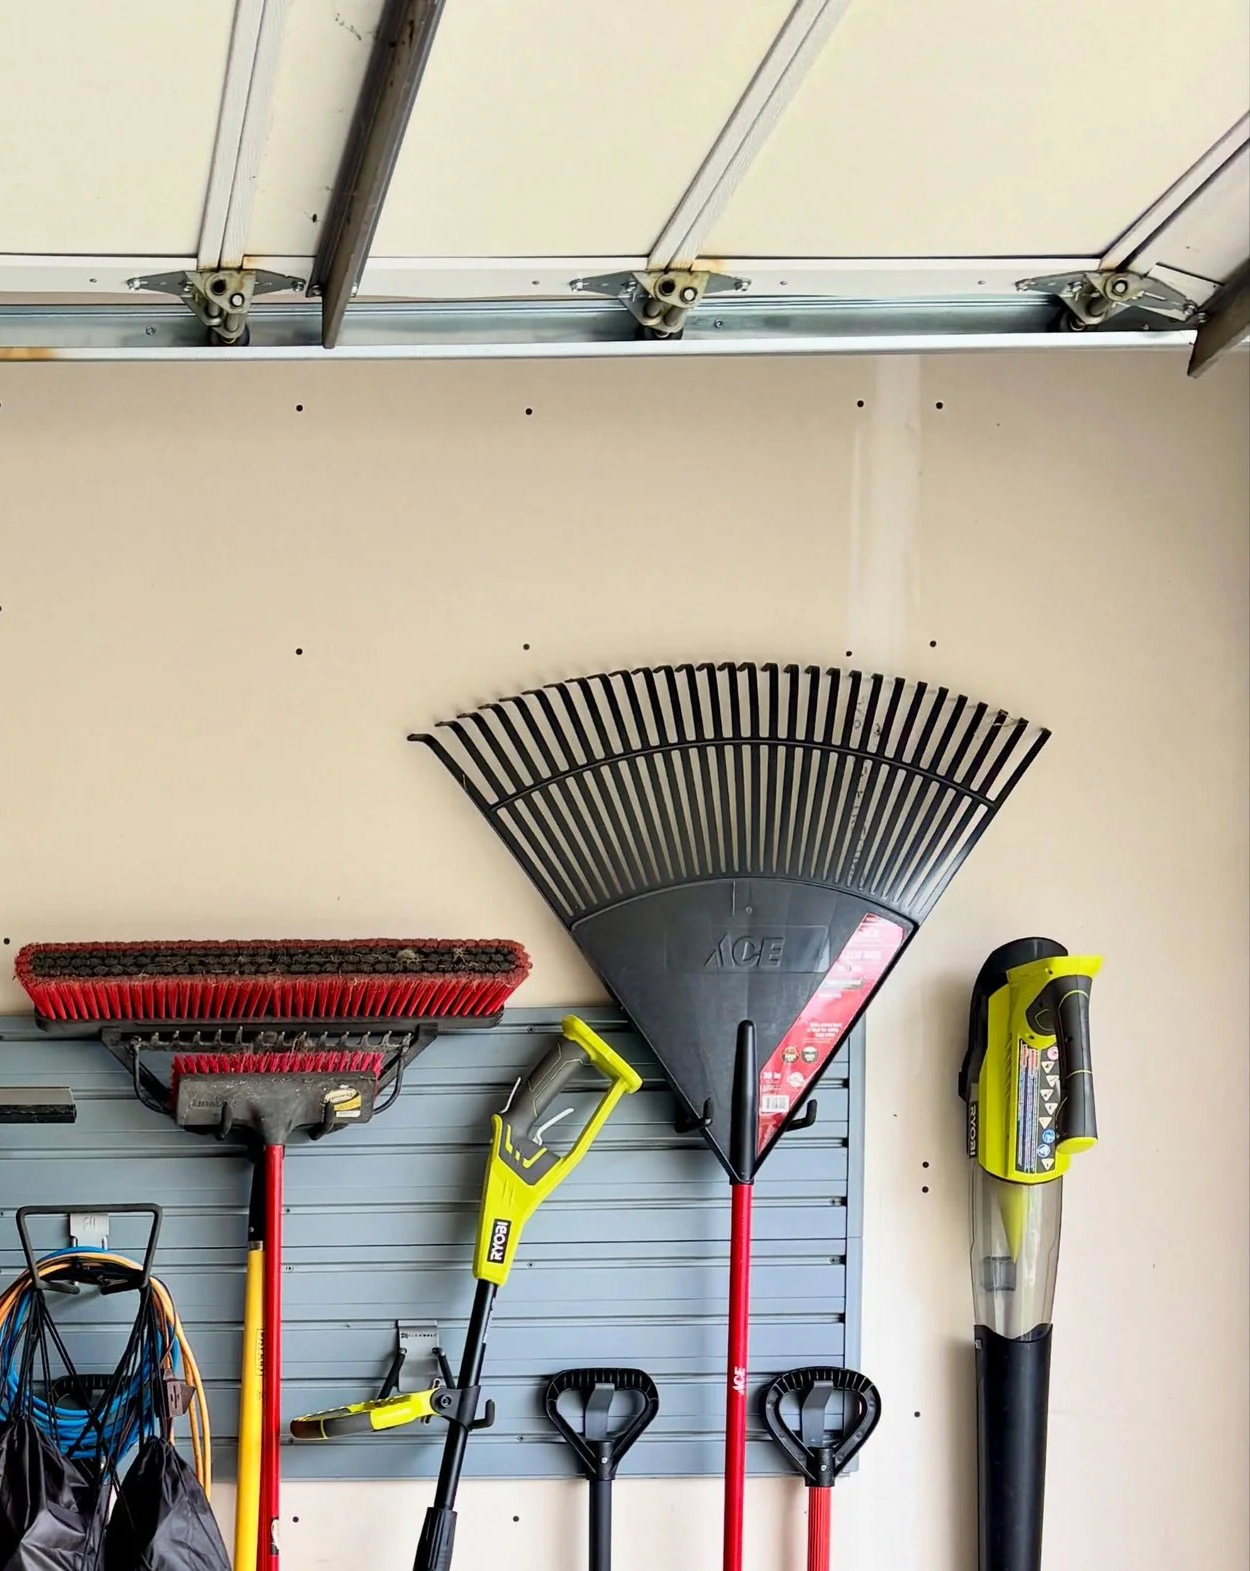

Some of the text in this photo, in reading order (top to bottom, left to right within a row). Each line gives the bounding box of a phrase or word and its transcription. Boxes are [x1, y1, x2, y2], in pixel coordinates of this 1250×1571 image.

[704, 932, 785, 968] ACE
[969, 1104, 977, 1157] RYOBI
[490, 1221, 509, 1261] RYOBI
[732, 1366, 746, 1397] ACE
